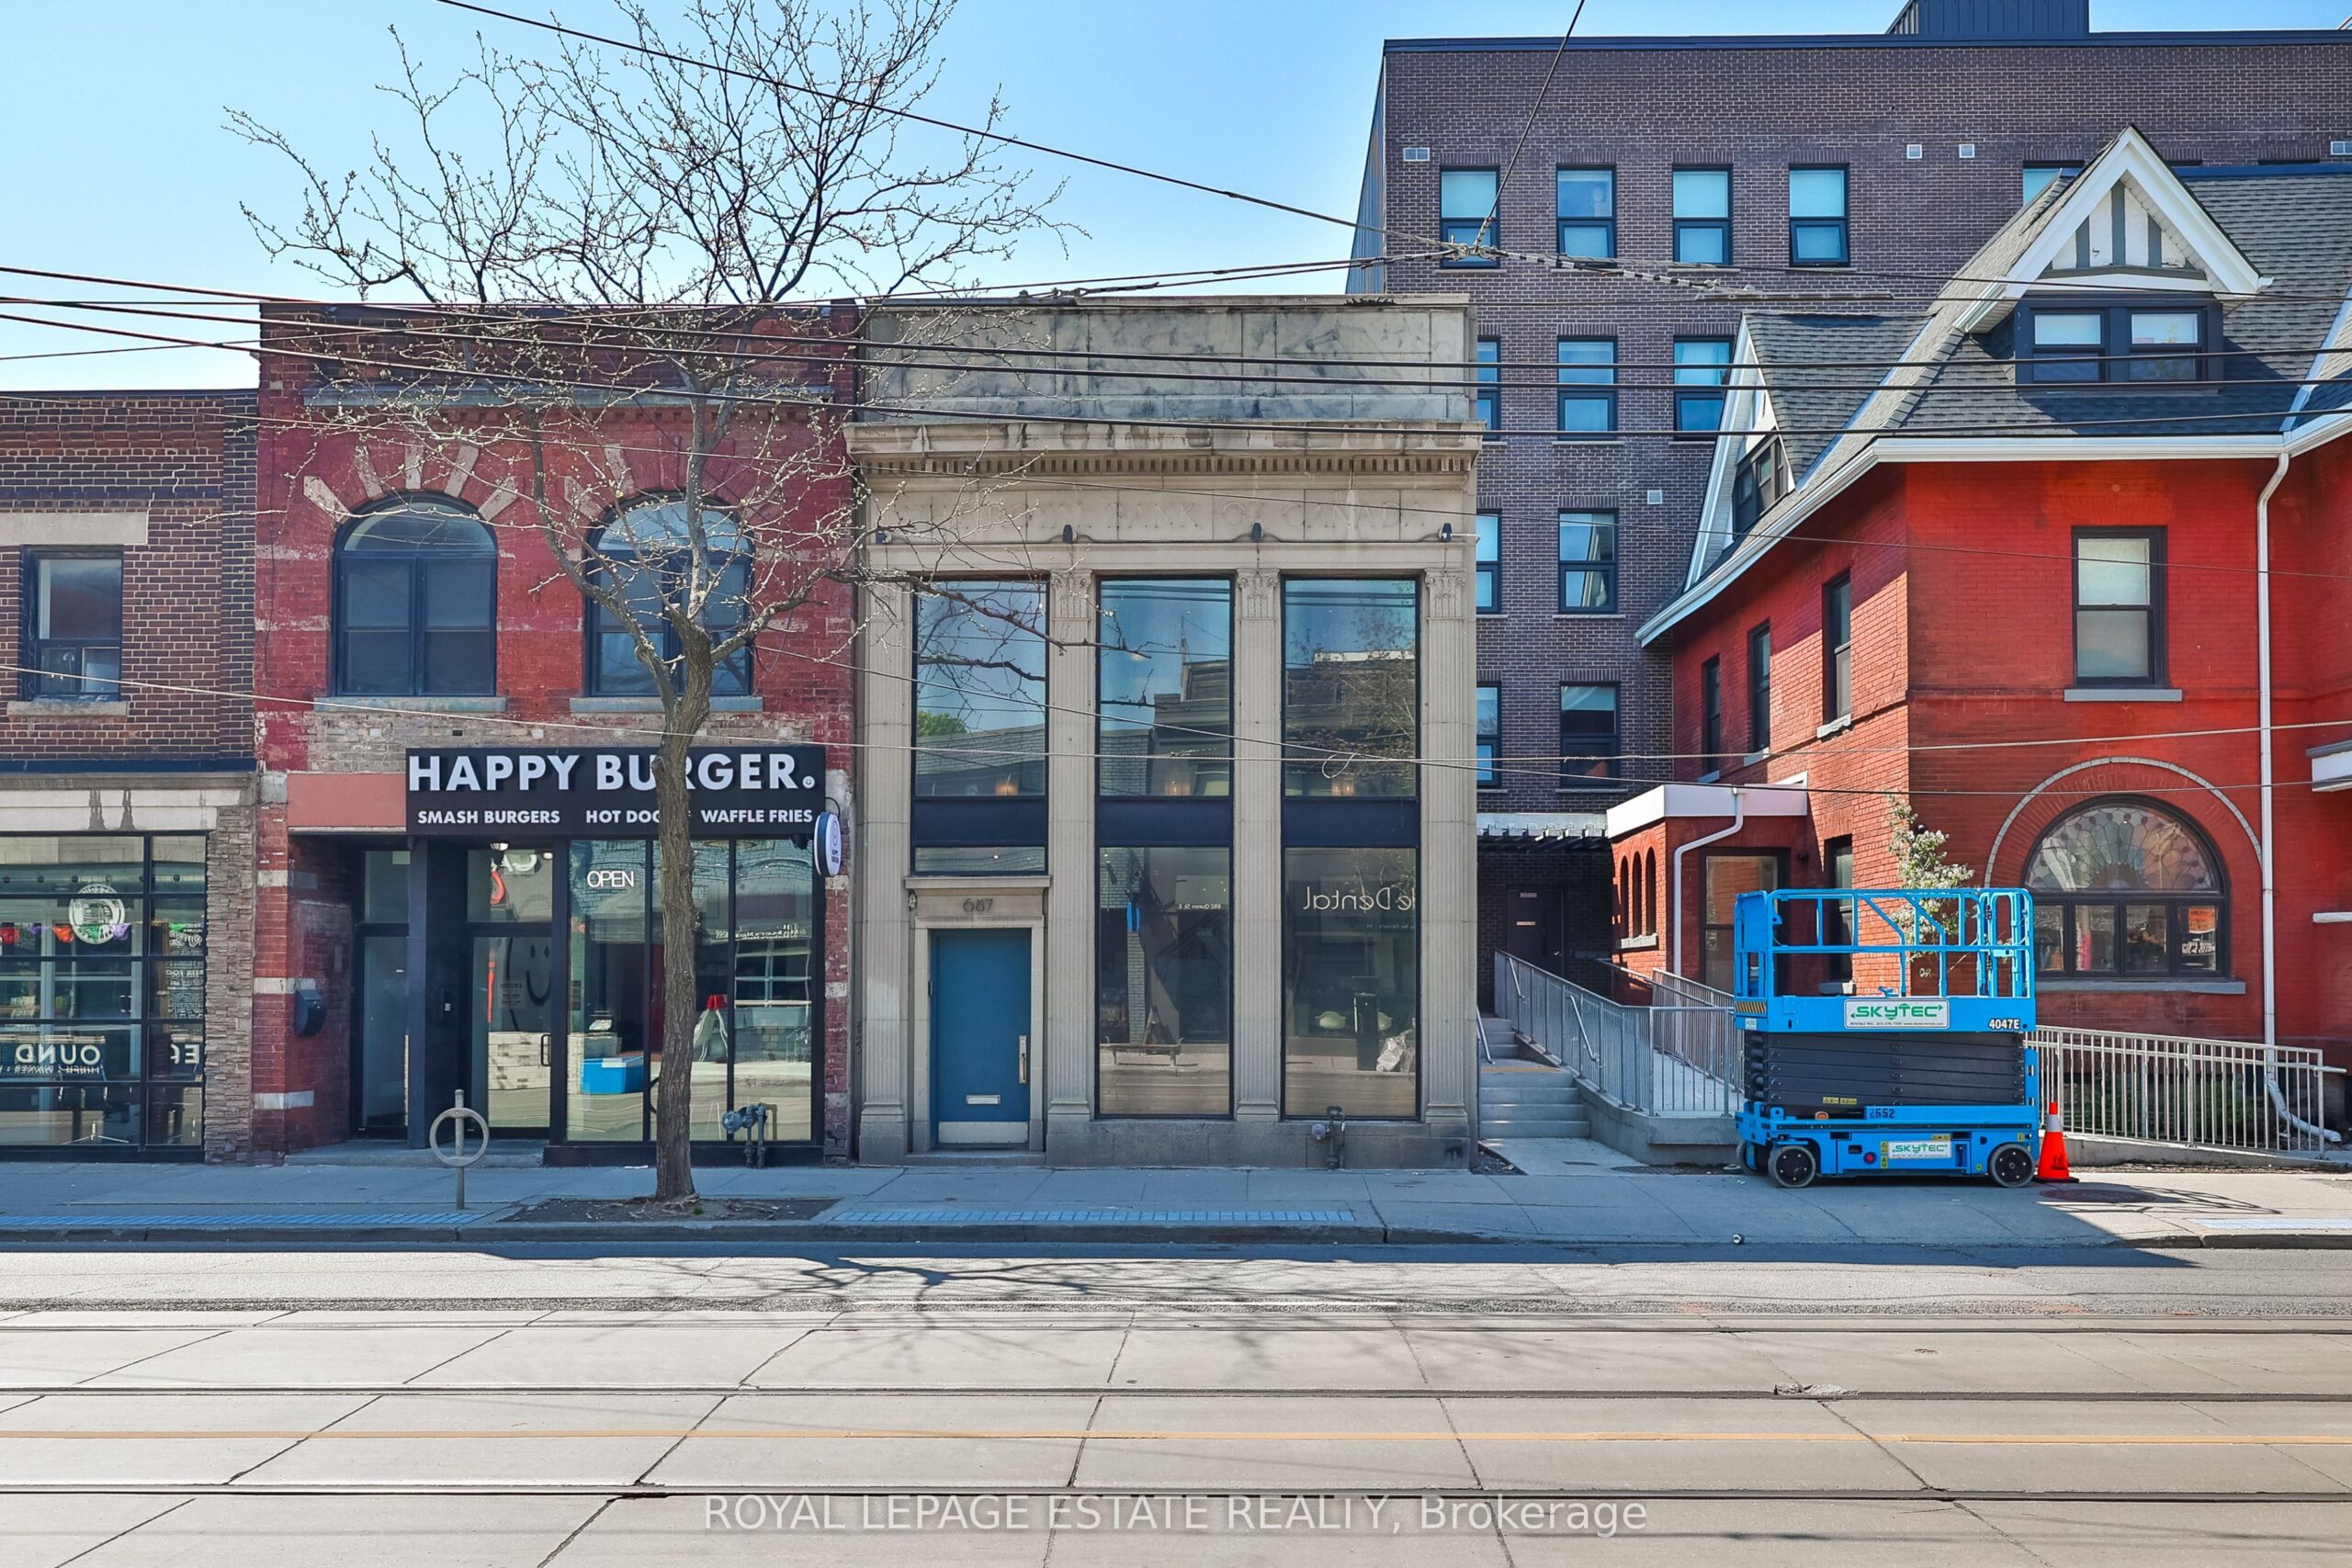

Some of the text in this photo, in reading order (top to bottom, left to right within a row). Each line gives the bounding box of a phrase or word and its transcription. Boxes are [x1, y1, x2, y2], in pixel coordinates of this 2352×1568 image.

[410, 755, 580, 791] HAPPY
[418, 810, 478, 824] SMASH
[484, 810, 560, 824] BURGERS
[586, 809, 621, 823] HOT
[701, 809, 764, 823] WAFFLE
[769, 809, 813, 823] FRIES
[586, 870, 635, 888] OPEN
[963, 897, 994, 912] 687
[1852, 1003, 1942, 1021] SKYTEC
[1989, 1019, 2020, 1030] 4047E
[1893, 1143, 1948, 1154] SKYTEC
